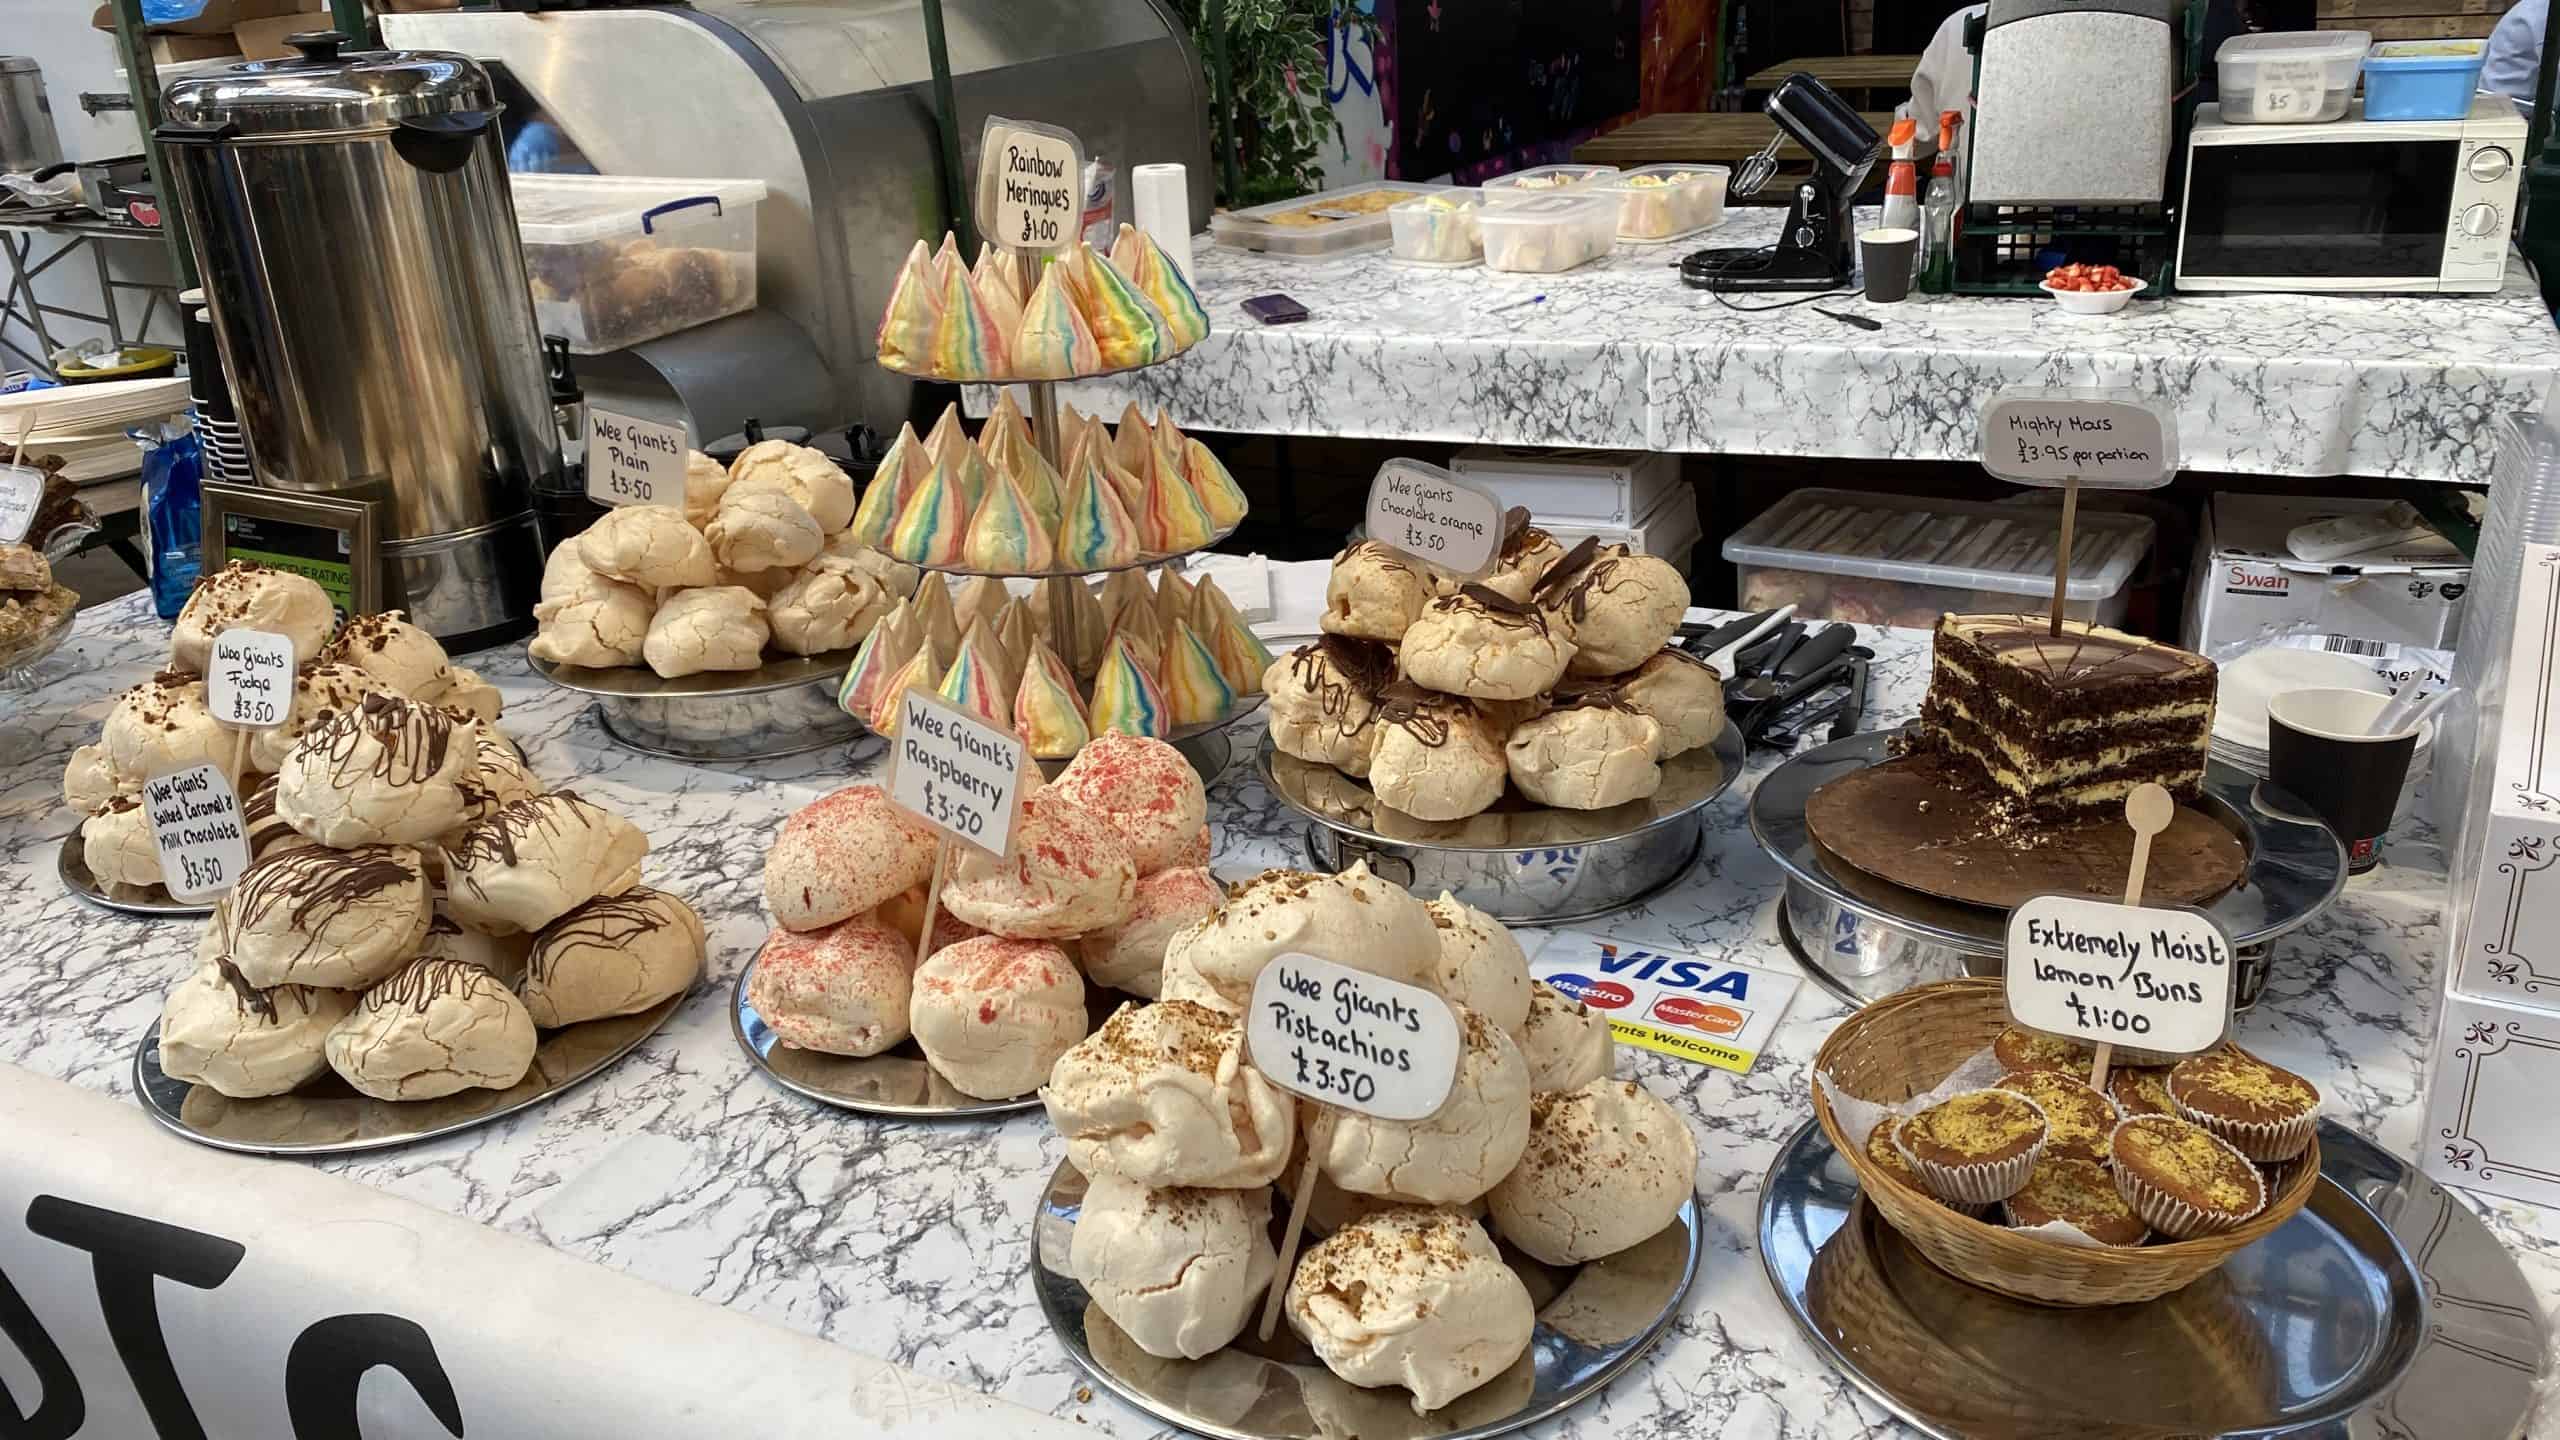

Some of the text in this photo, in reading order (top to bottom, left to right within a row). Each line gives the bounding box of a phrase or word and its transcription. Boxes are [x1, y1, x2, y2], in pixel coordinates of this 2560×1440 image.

[1008, 145, 1064, 178] Rainbow
[1006, 177, 1070, 214] Meringues
[593, 417, 677, 454] Wee Giant's
[2009, 416, 2113, 437] Mighty Mars
[608, 446, 649, 472] Plain
[2018, 437, 2069, 463] £3.95
[2096, 448, 2149, 465] portion
[1387, 475, 1453, 508] Wee Giants
[1380, 498, 1483, 540] Chocolate orange
[2229, 566, 2289, 589] Swan
[243, 647, 284, 671] Giants
[226, 670, 271, 696] Fudge
[908, 700, 1014, 772] Wee Giant's
[906, 739, 1003, 812] Raspberry
[154, 804, 184, 828] Salted
[184, 793, 226, 820] Caramel
[160, 821, 240, 851] Milk Chocolate
[2028, 918, 2225, 983] Extremely Moist
[1592, 941, 1749, 1001] VISA
[1279, 966, 1421, 1032] Wee Giants
[1551, 979, 1625, 1002] Maestro
[2133, 972, 2203, 1004] Buns
[1656, 1003, 1740, 1027] MasterCard
[1268, 1001, 1411, 1072] Pistachios
[1653, 1031, 1740, 1062] Welcome
